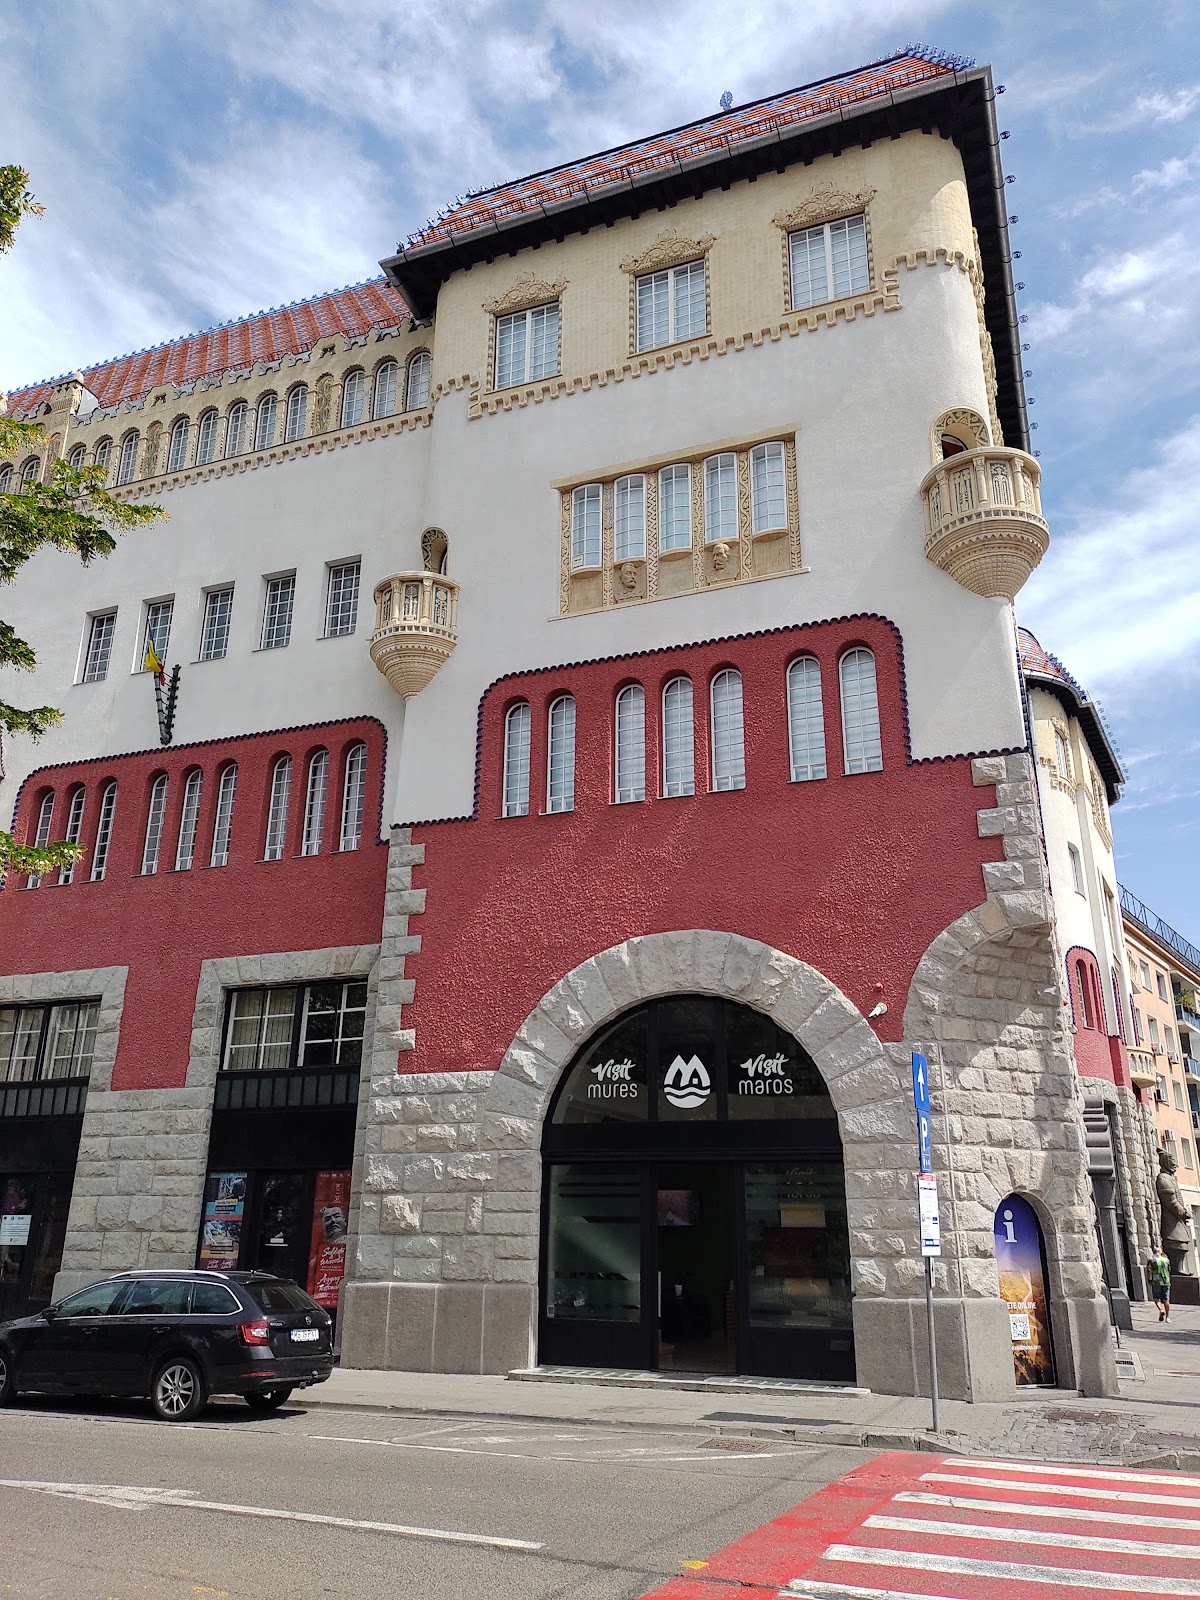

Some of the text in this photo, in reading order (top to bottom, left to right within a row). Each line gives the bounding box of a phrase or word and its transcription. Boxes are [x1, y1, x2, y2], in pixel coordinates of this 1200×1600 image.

[590, 1057, 637, 1082] Visit
[740, 1052, 790, 1078] Visit
[587, 1082, 639, 1099] mures
[738, 1077, 794, 1096] maros
[920, 1116, 929, 1152] P
[1002, 1209, 1018, 1243] i
[1017, 1301, 1037, 1310] ONLINE
